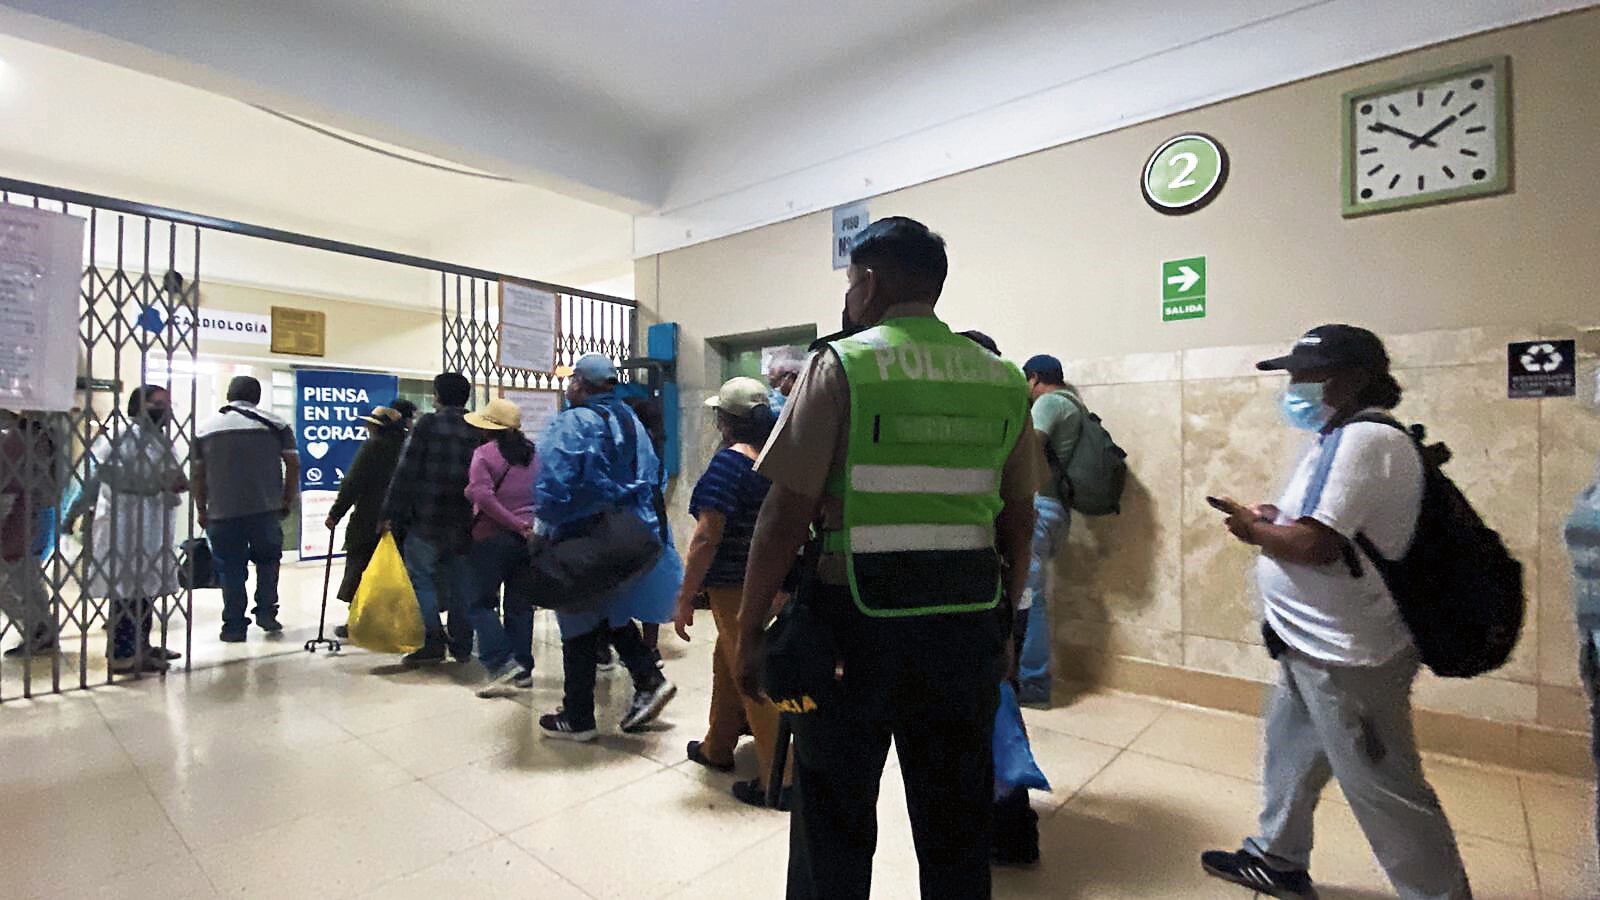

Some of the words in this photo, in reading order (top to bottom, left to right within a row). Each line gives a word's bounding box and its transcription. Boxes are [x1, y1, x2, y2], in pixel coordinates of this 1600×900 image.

[1168, 152, 1198, 189] 2
[1165, 303, 1204, 315] SALIDA
[303, 387, 369, 403] PIENSA
[303, 405, 329, 421] EN
[333, 406, 358, 422] TU
[303, 425, 370, 441] CORAZ
